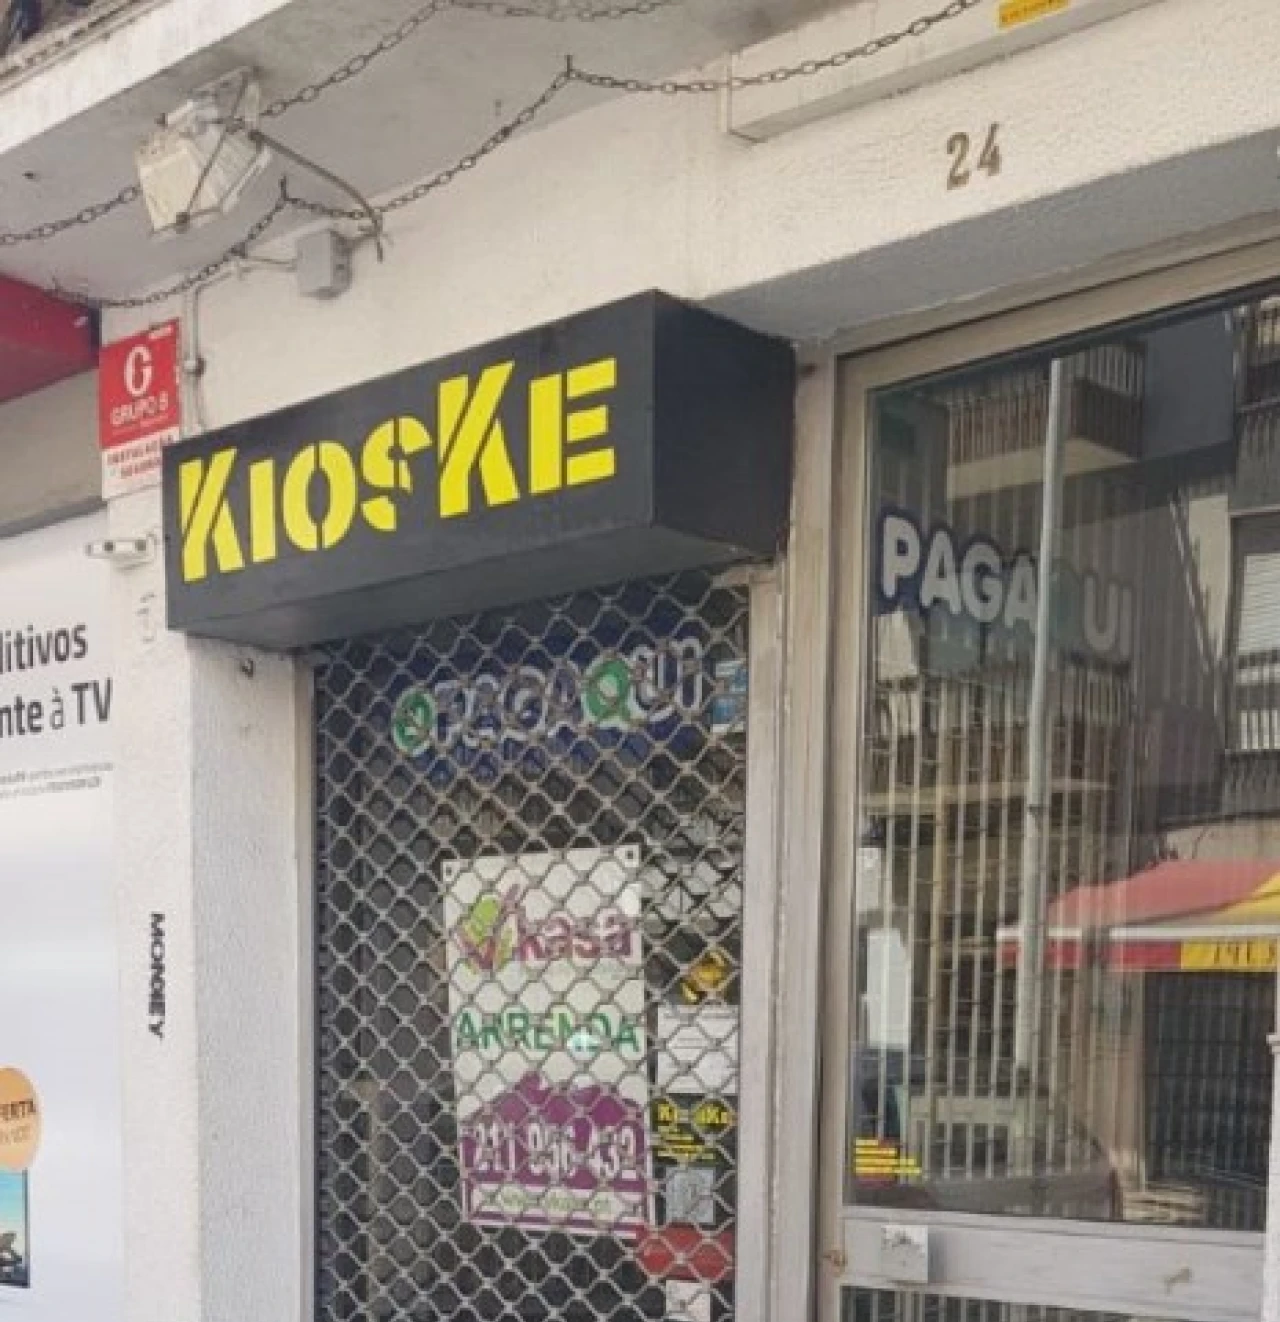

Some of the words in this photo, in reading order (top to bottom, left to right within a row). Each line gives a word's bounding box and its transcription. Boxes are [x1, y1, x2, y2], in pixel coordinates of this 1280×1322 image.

[945, 122, 1002, 190] 24
[110, 396, 157, 428] GRUPO
[882, 513, 1133, 657] PAGAUI
[51, 685, 65, 730] à
[70, 676, 114, 727] TV
[456, 1010, 641, 1053] ARRENDA
